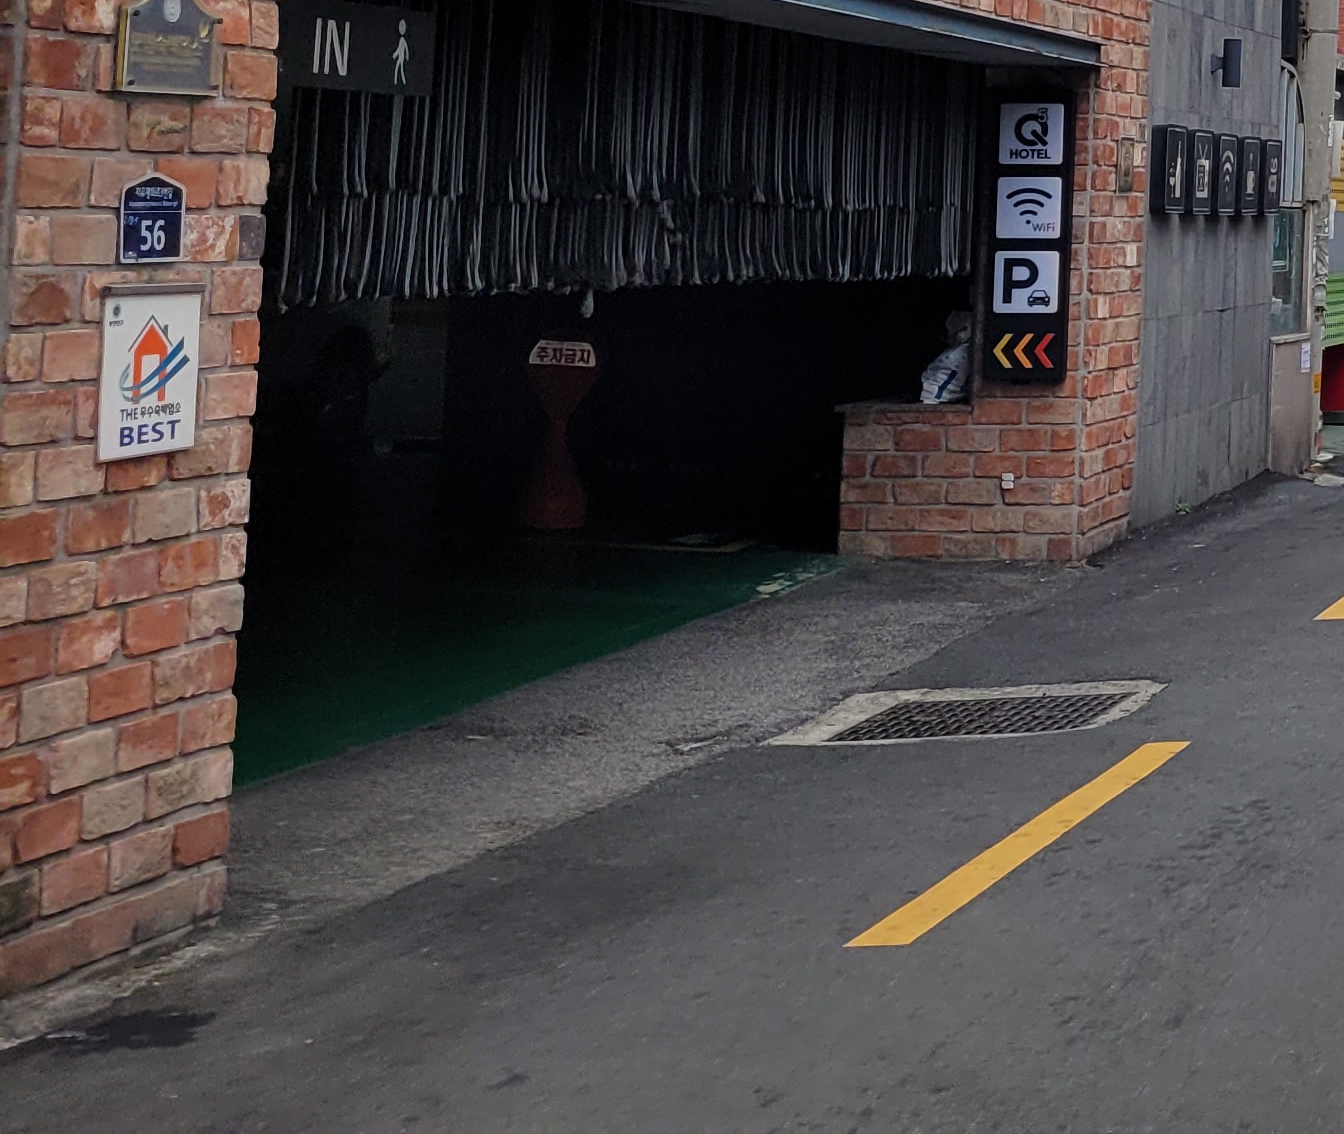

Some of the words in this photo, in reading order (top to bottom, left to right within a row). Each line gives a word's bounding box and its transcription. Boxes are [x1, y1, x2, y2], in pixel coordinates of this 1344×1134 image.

[313, 17, 350, 76] IN
[1037, 107, 1049, 122] 5
[1014, 114, 1049, 147] Q
[1009, 148, 1052, 160] HOTEL
[140, 219, 166, 251] 56
[1032, 222, 1056, 234] WiFi
[1001, 257, 1039, 304] P
[534, 345, 592, 366] 주차금지
[120, 407, 138, 422] THE
[120, 418, 182, 447] BEST
